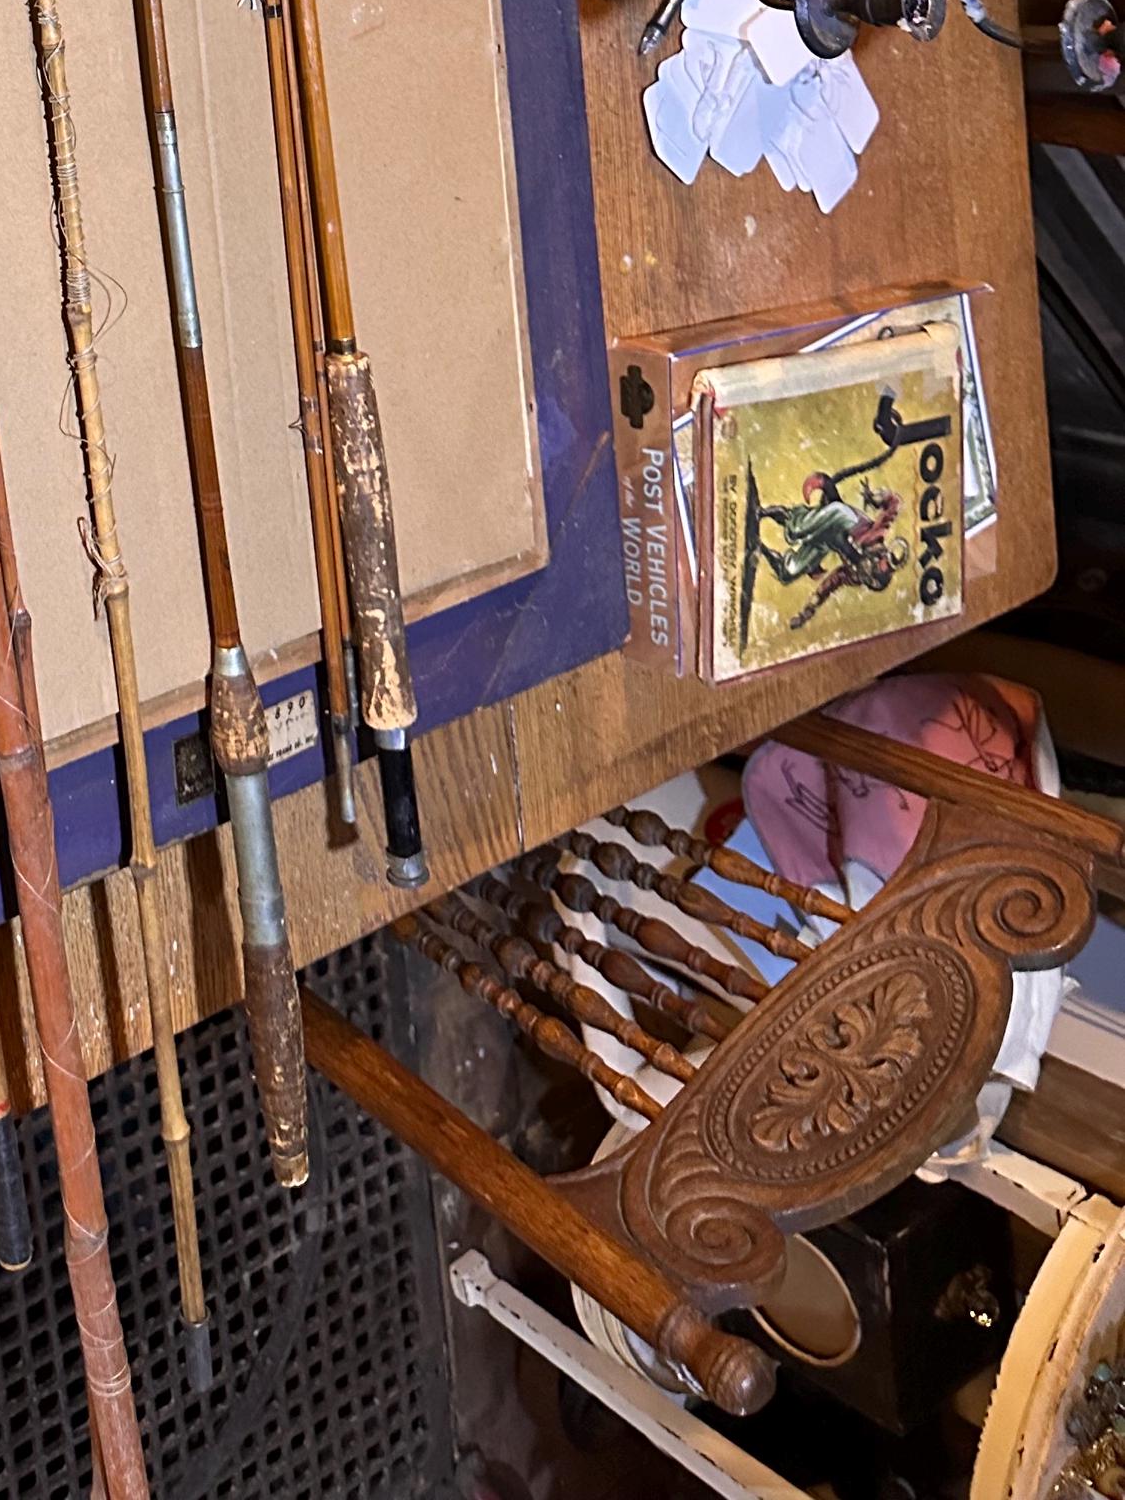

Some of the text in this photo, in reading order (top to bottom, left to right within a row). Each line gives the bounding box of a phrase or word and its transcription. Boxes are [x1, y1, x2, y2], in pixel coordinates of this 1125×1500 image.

[641, 447, 669, 647] POST VEHICLES
[729, 474, 737, 494] BY
[873, 385, 952, 606] Jocko
[621, 517, 643, 607] WORLD
